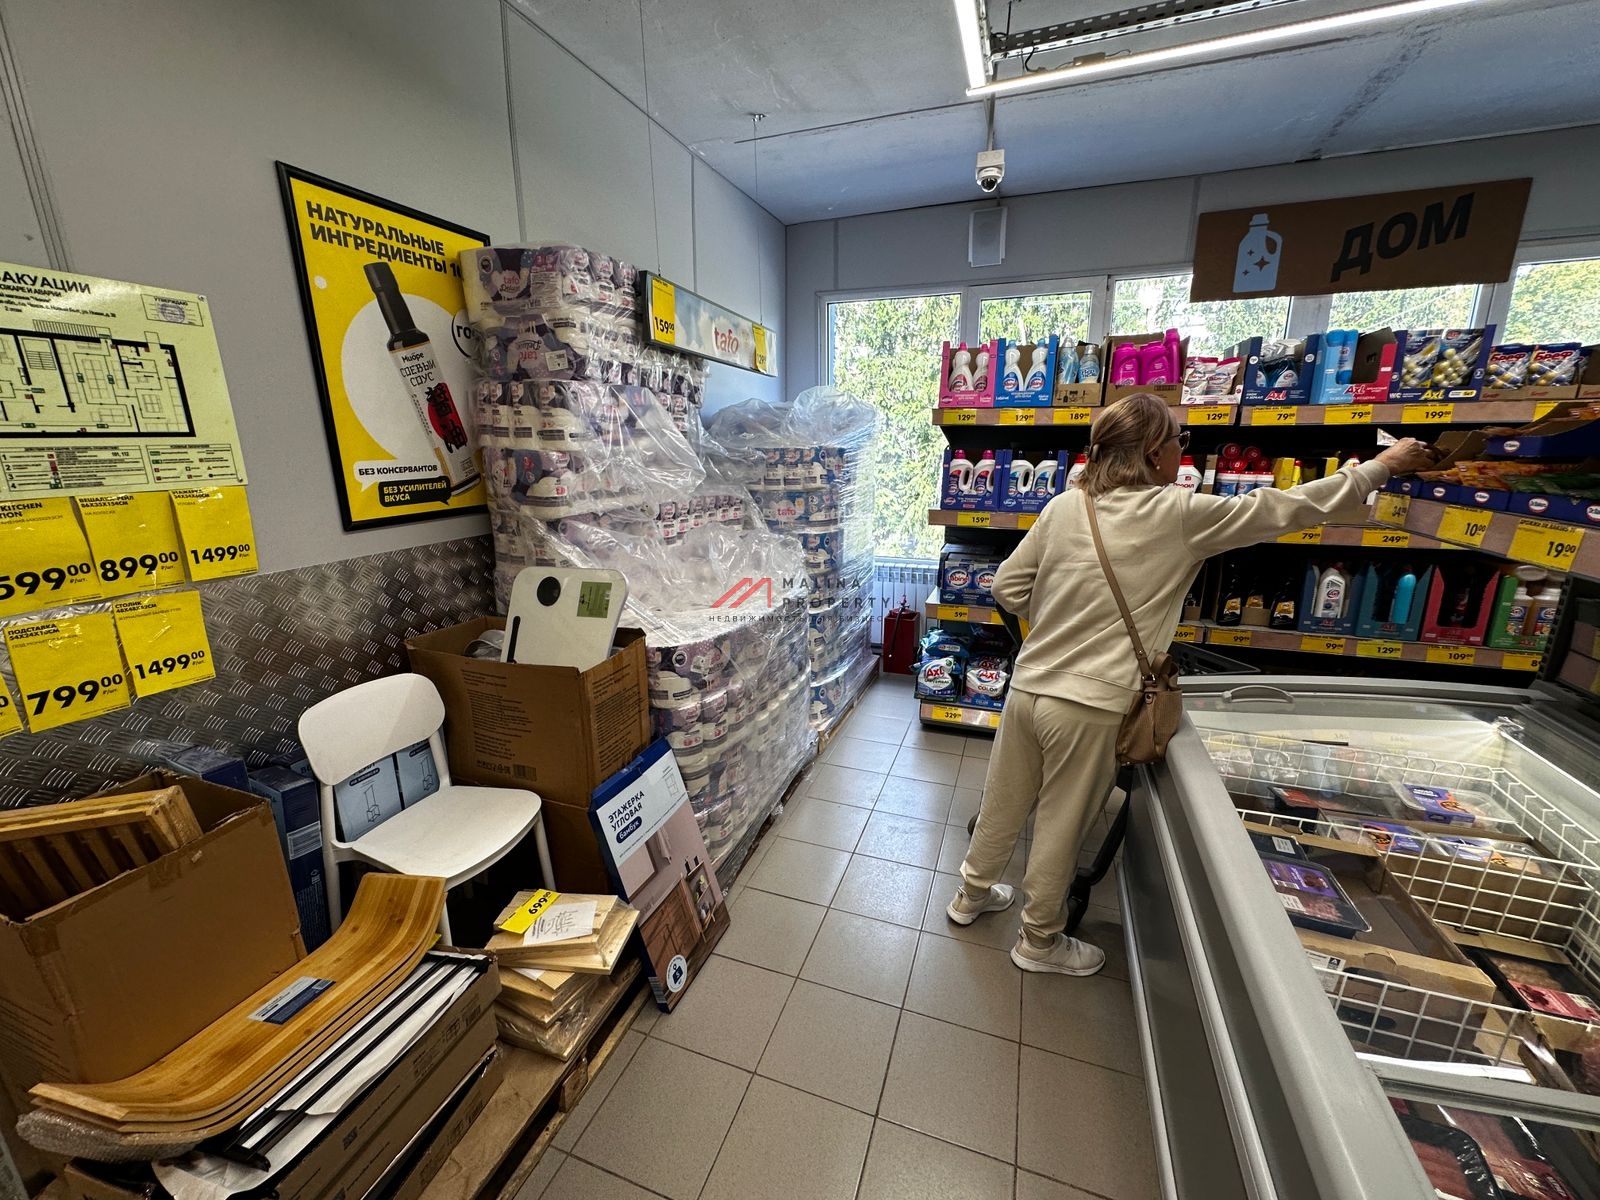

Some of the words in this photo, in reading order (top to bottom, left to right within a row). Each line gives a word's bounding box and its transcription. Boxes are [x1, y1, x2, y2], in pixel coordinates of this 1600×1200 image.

[306, 200, 445, 257] НАТУРАЛЬНЫЕ
[1330, 190, 1476, 284] ДОМ
[310, 222, 447, 274] ИНГРЕДИЕНТЫ
[0, 271, 92, 295] АКУАЦИИ
[655, 317, 668, 335] 159
[714, 327, 739, 354] tafo
[1490, 352, 1527, 362] Бреф
[1534, 350, 1574, 361] Бреф
[410, 372, 435, 387] СОУС
[1264, 390, 1287, 401] Axl
[1343, 384, 1366, 395] Axl
[1420, 390, 1445, 401] Axl
[1069, 412, 1084, 420] 189
[1206, 413, 1221, 421] 129
[1351, 412, 1363, 420] 79
[1424, 411, 1444, 419] 199
[358, 468, 375, 476] БЕЗ
[376, 464, 438, 475] КОНСЕРВАНТОВ
[383, 486, 398, 494] БЕЗ
[399, 480, 447, 492] УСИЛИТЕЛЕЙ
[384, 494, 410, 503] ВКУСА
[1, 502, 43, 512] KITCHEN
[1464, 522, 1479, 537] 10
[1382, 535, 1401, 543] 249
[190, 545, 238, 565] 1499
[1547, 540, 1565, 558] 19
[100, 553, 158, 582] 899
[0, 567, 67, 600] 599
[115, 600, 142, 609] СТОЛИК
[8, 623, 57, 636] ПОДСТАВКА
[1376, 645, 1393, 654] 129
[1448, 651, 1466, 660] 109
[134, 654, 190, 680] 1499
[27, 680, 100, 716] 799
[608, 790, 645, 824] ЭТАЖЕРКА
[612, 801, 643, 832] УГЛОВАЯ
[619, 818, 641, 840] бамбук
[527, 897, 548, 915] 699
